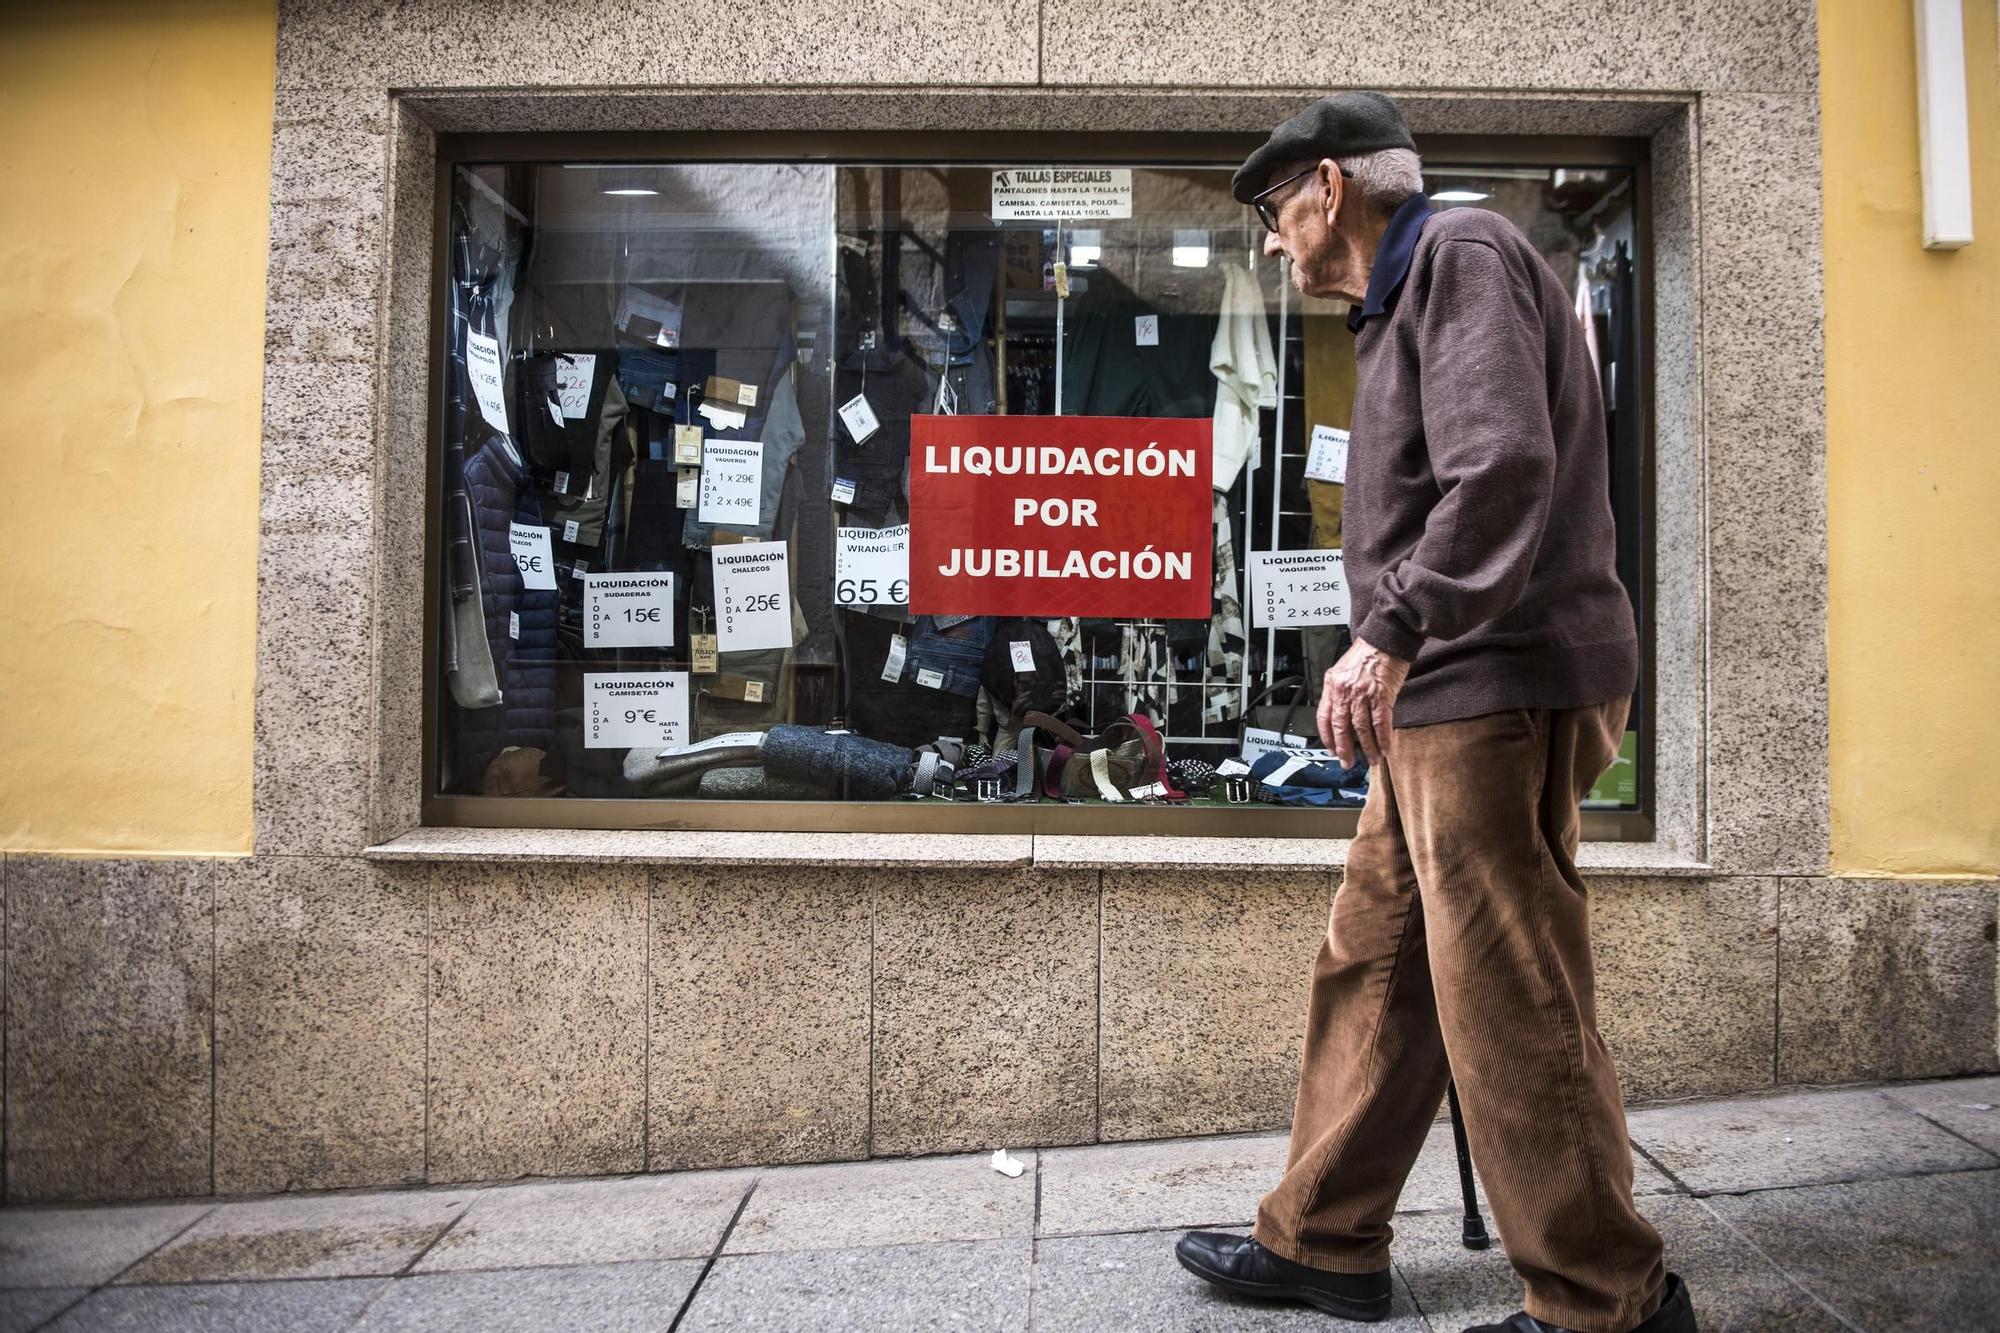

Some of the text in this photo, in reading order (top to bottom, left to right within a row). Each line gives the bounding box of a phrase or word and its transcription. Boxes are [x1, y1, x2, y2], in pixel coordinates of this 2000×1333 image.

[1015, 171, 1112, 183] TALLAS ESPECIALES
[705, 447, 759, 456] LIQUIDACIÓN
[925, 442, 1196, 477] LIQUIDACIÓN
[735, 474, 755, 483] 29€
[734, 498, 754, 507] 49€
[1014, 498, 1099, 527] POR
[847, 543, 905, 552] WRANGLER
[717, 552, 784, 565] LIQUIDACIÓN
[938, 544, 1192, 580] JUBILACIÓN
[1262, 555, 1344, 565] LIQUIDACIÓN
[732, 566, 770, 574] CHALECOS
[589, 578, 668, 588] LIQUIDACIÓN
[1287, 584, 1293, 592] 1
[1313, 581, 1340, 591] 29€
[745, 594, 781, 612] 25€
[623, 608, 661, 623] 15€
[1288, 608, 1296, 617] 2
[1313, 606, 1341, 616] 49€
[594, 680, 674, 689] LIQUIDACIÓN
